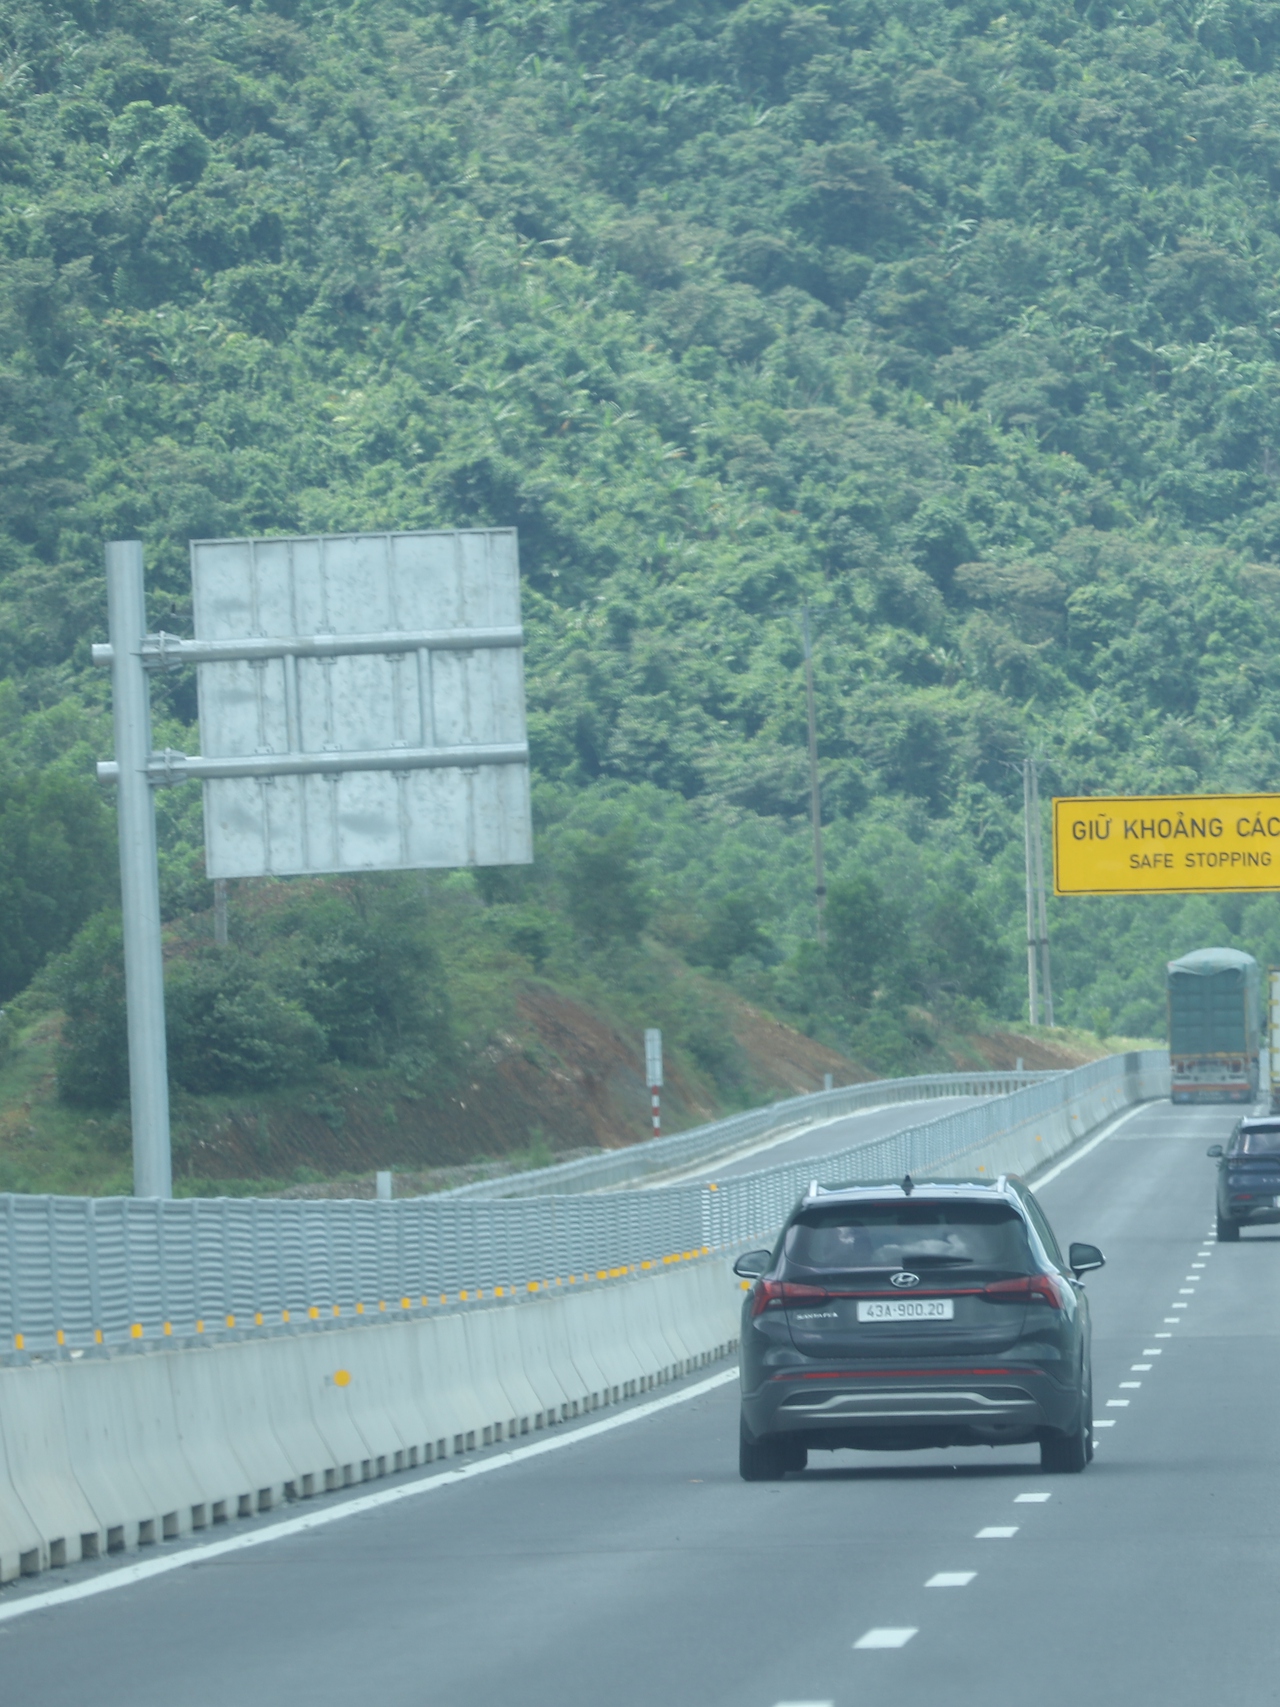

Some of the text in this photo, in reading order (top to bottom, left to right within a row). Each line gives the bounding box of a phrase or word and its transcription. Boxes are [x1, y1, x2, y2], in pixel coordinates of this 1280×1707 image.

[1072, 813, 1112, 840] GIỮ
[1124, 811, 1223, 839] KHOẢNG
[1130, 853, 1174, 869] SAFE
[1185, 852, 1271, 867] STOPPING
